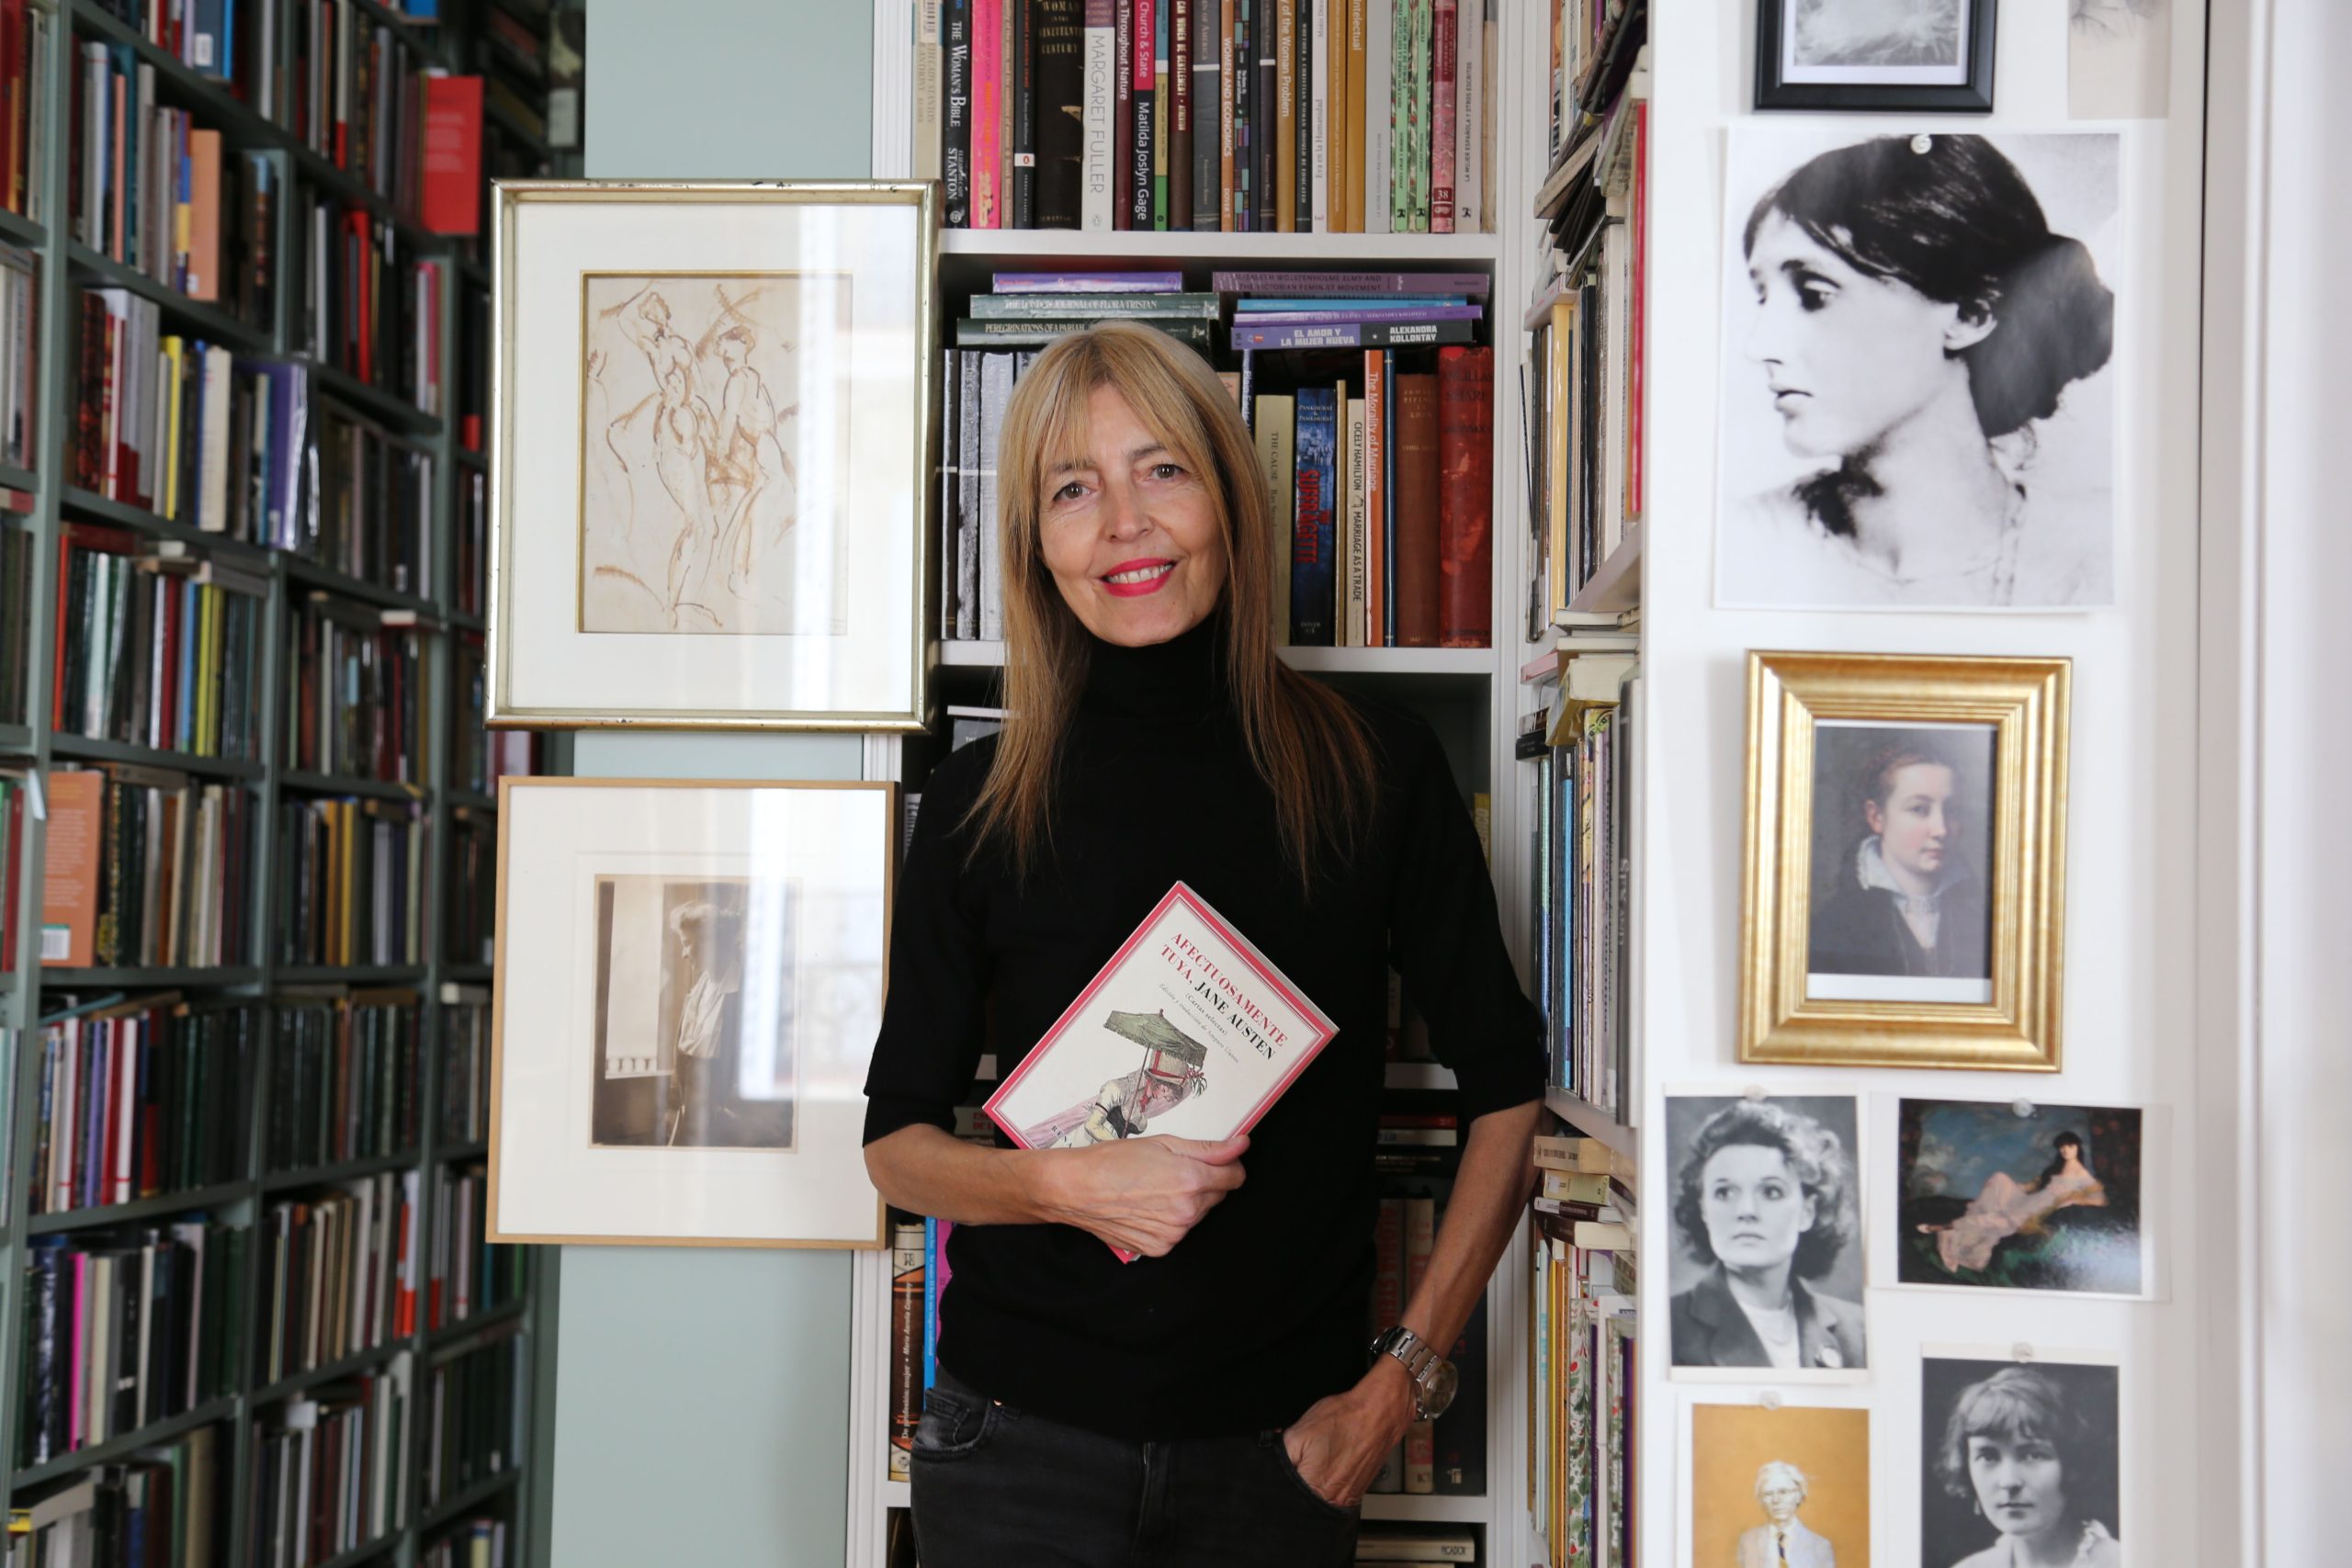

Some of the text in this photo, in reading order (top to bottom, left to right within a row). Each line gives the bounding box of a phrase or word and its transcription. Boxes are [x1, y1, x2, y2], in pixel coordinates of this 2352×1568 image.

[952, 21, 962, 40] THE
[1117, 8, 1129, 64] Throughout
[1139, 2, 1149, 77] Church & State
[1202, 24, 1210, 61] AMERICA
[1282, 6, 1292, 117] of the Woman Problem
[1091, 35, 1106, 125] MARGARET
[1119, 66, 1128, 101] Nature
[950, 96, 967, 127] BIBLE
[1464, 118, 1472, 151] ESPAÑOLA
[947, 147, 957, 200] STANTON
[1090, 130, 1104, 193] FULLER
[1134, 102, 1149, 220] Matilda Joslyn Gage
[1317, 154, 1323, 164] en
[1438, 189, 1449, 198] 38
[1101, 299, 1125, 310] FLORA
[1126, 299, 1158, 310] TRISTAN
[985, 323, 1042, 333] PEREGRINATIONS
[1294, 330, 1305, 338] EL
[1307, 329, 1332, 337] AMOR
[1295, 337, 1323, 345] MUJER
[1326, 336, 1354, 344] NUEVA
[1389, 325, 1437, 334] ALEXANDRA
[1389, 334, 1437, 343] KOLLONTAY
[1369, 371, 1378, 390] The
[1367, 393, 1378, 433] Morality
[1353, 421, 1363, 491] CICELY HAMILTON
[1369, 435, 1378, 446] of
[1271, 451, 1279, 481] CAUSE
[1295, 469, 1319, 564] SUFFRAGETTE
[1353, 511, 1362, 555] MARRIAGE
[1353, 555, 1362, 566] AS
[1352, 575, 1362, 603] TRADE
[1160, 944, 1277, 1061] TUYA, JANE AUSTEN
[1170, 932, 1288, 1047] AFECTUOSAMENTE
[1185, 992, 1227, 1036] (Cartas selectas)
[901, 1427, 910, 1438] De
[1441, 1546, 1466, 1555] PICADOR
